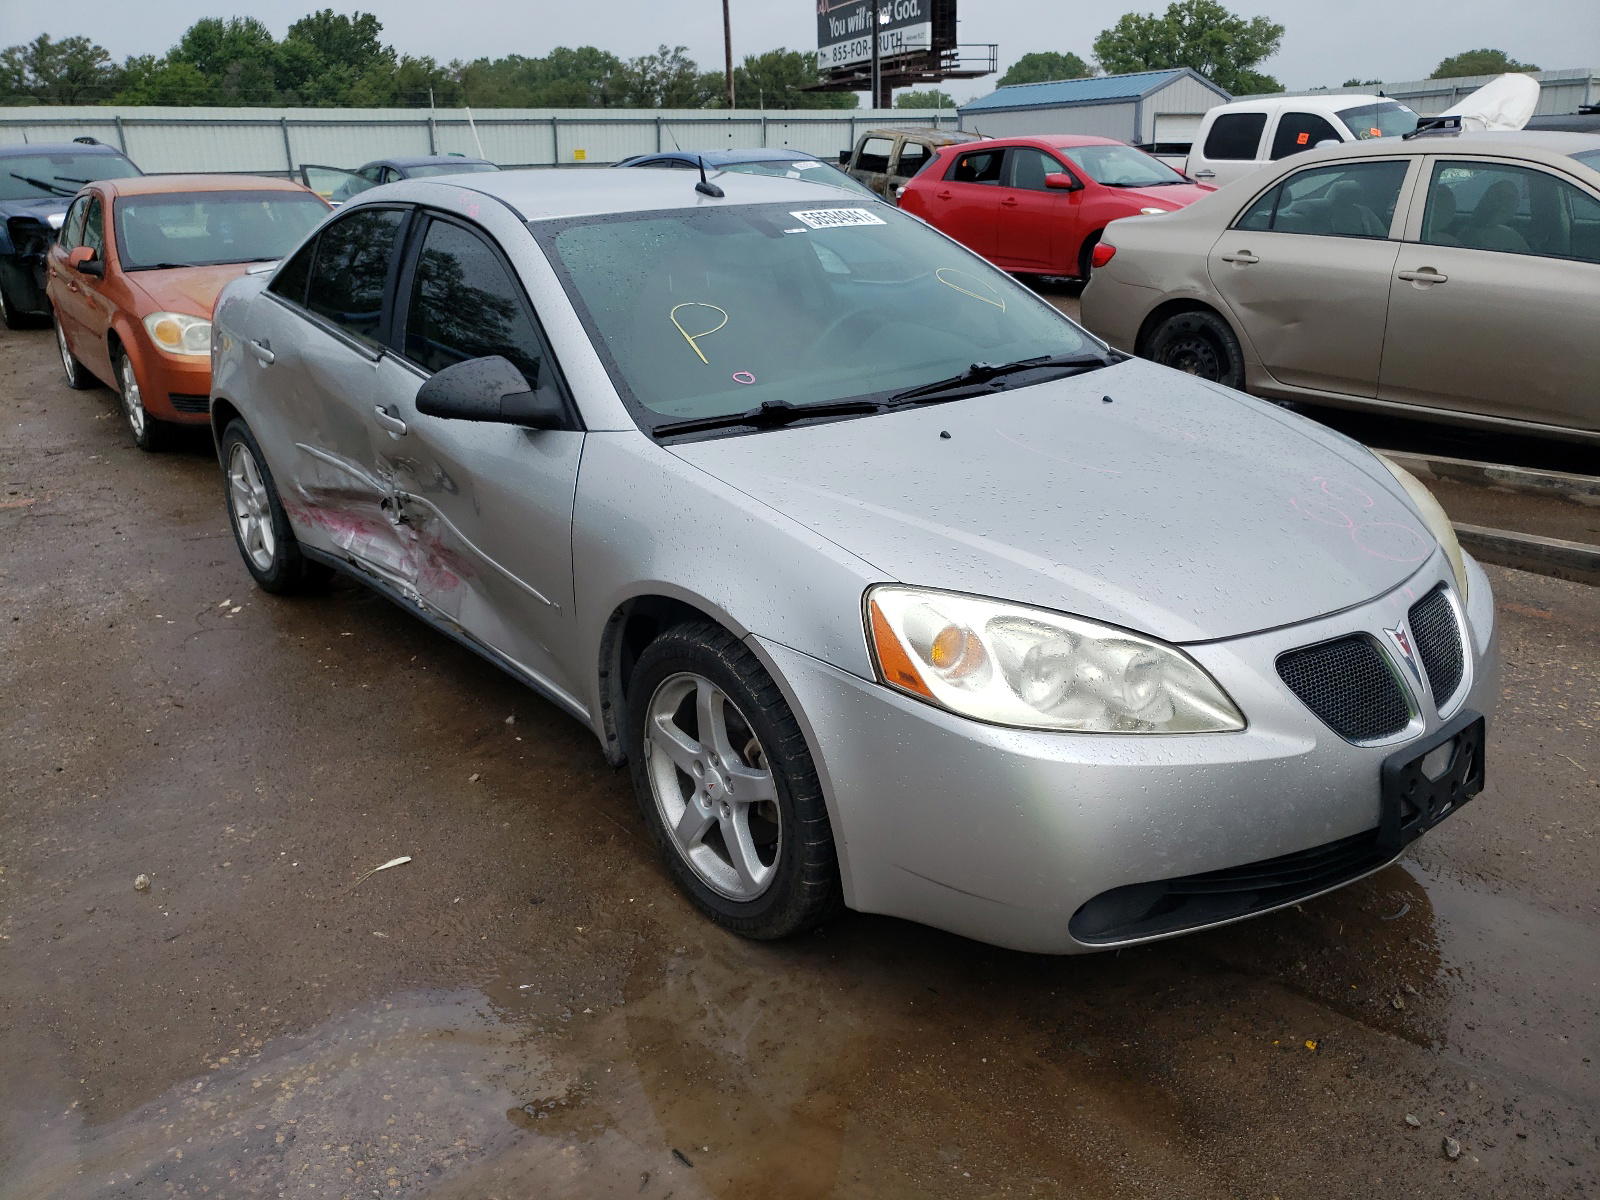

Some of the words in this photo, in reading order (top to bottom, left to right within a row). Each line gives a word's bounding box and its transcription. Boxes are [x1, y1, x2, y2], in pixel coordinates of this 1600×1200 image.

[829, 17, 845, 38] You
[848, 6, 865, 33] will
[894, 0, 921, 21] God.
[833, 32, 903, 62] 855-FOR-RUTH
[670, 302, 728, 364] P
